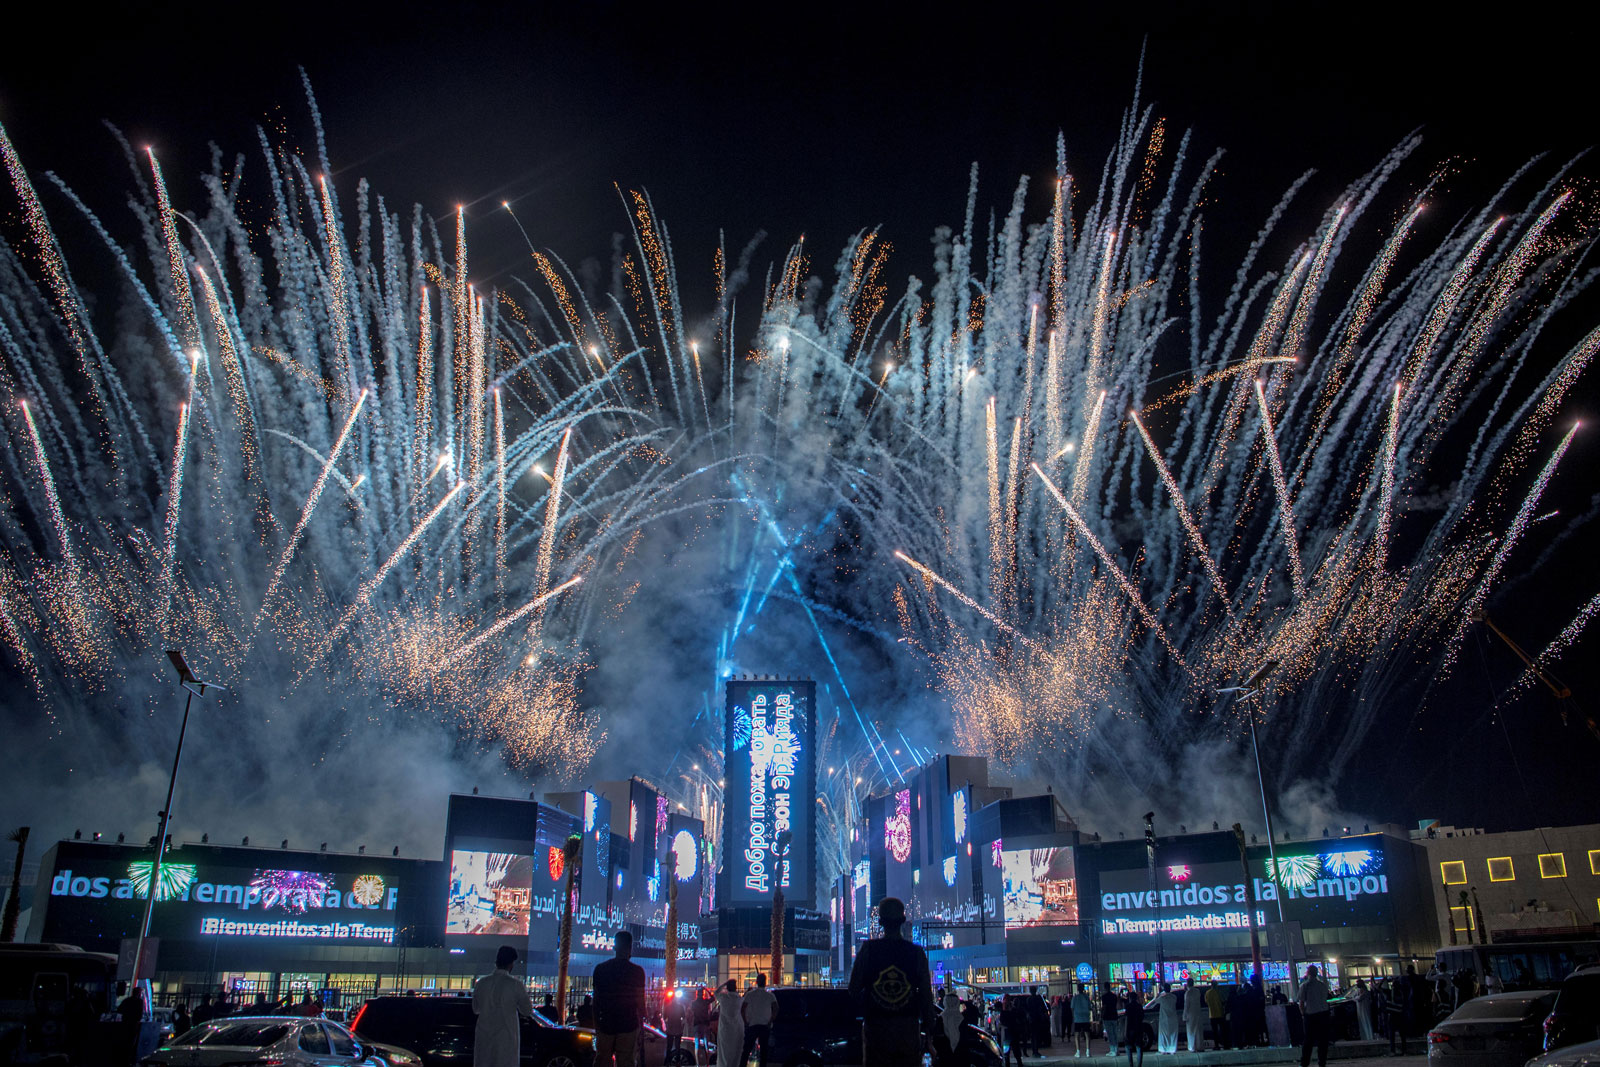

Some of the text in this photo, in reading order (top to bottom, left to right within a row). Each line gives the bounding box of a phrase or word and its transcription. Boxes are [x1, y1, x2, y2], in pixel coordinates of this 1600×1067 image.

[744, 693, 769, 892] Добро пожаовать
[1253, 877, 1278, 902] la
